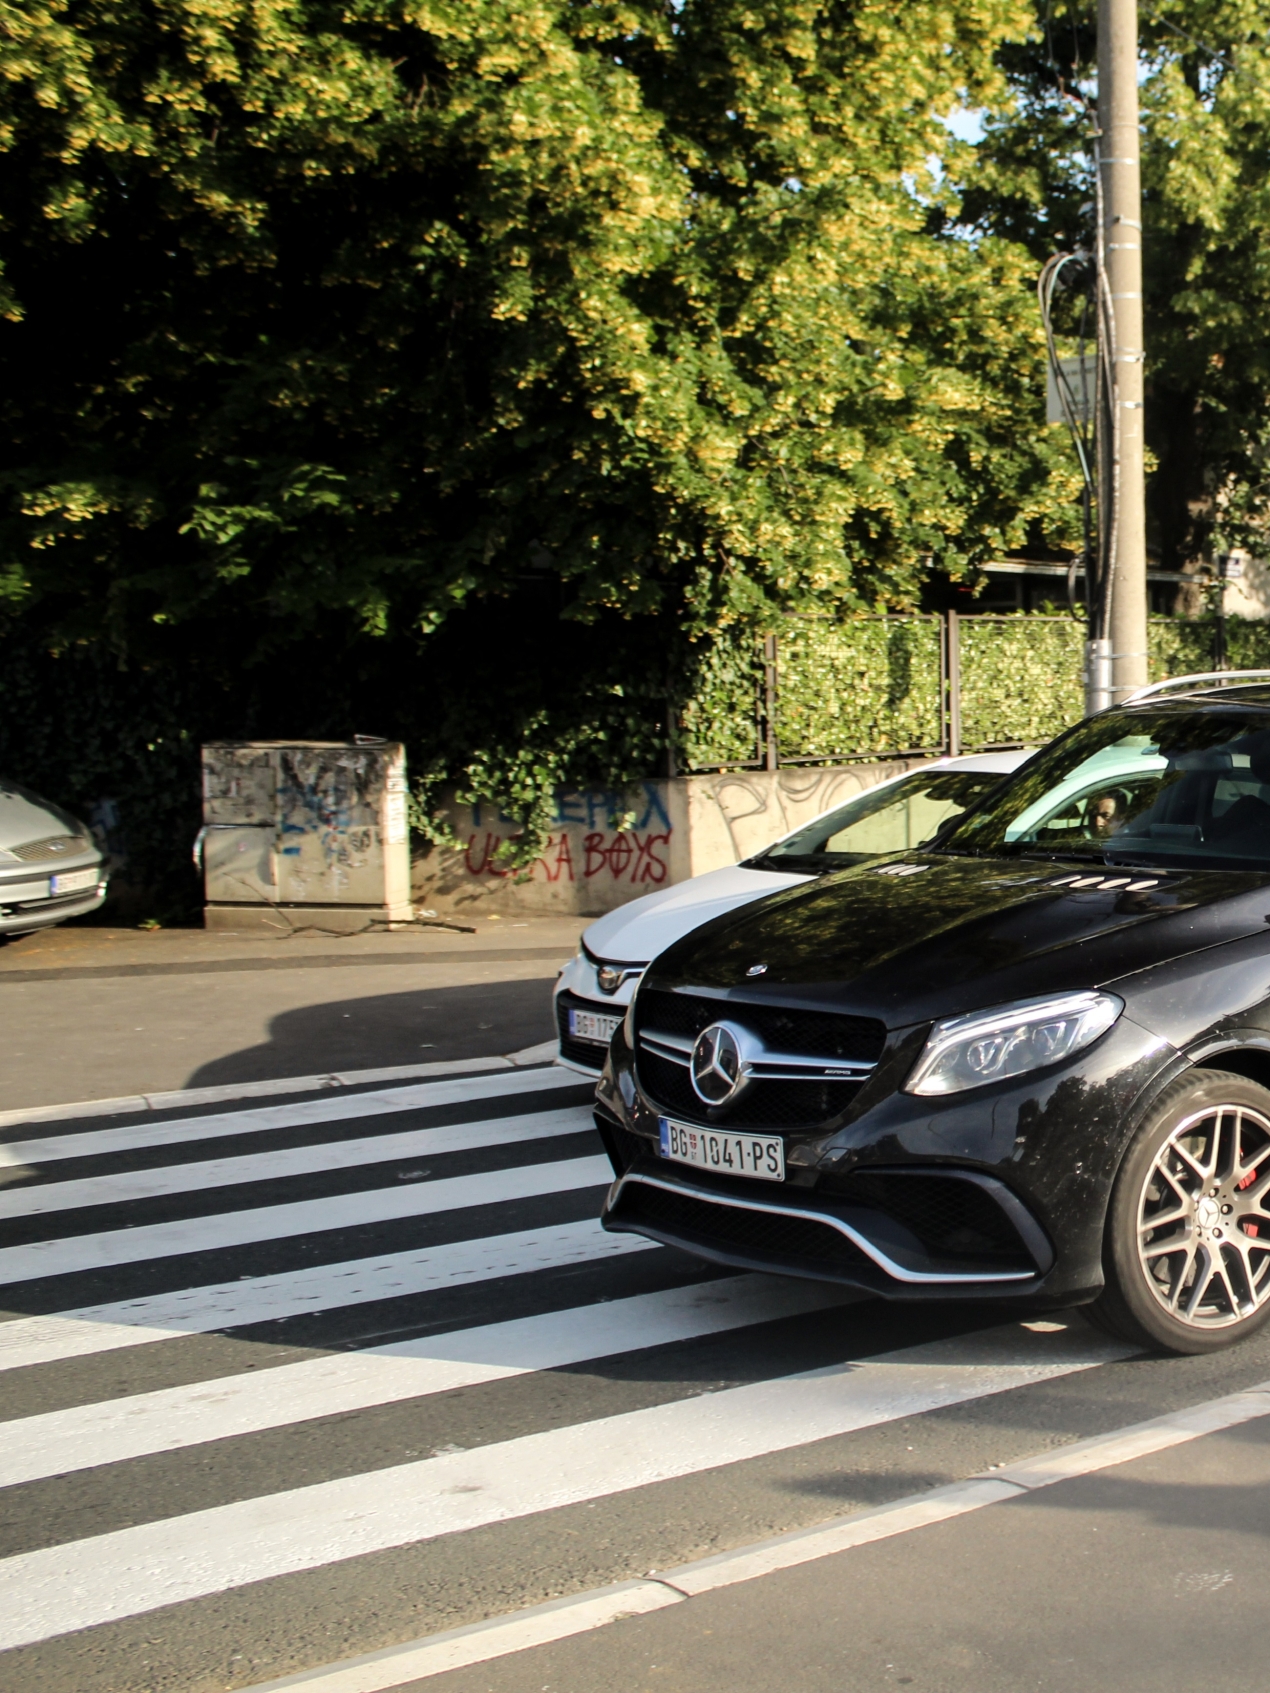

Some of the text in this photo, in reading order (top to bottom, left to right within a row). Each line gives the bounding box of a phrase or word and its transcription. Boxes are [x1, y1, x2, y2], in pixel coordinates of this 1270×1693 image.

[465, 828, 673, 884] ULRA BOYS
[576, 1014, 589, 1035] BG
[670, 1125, 688, 1158] BG
